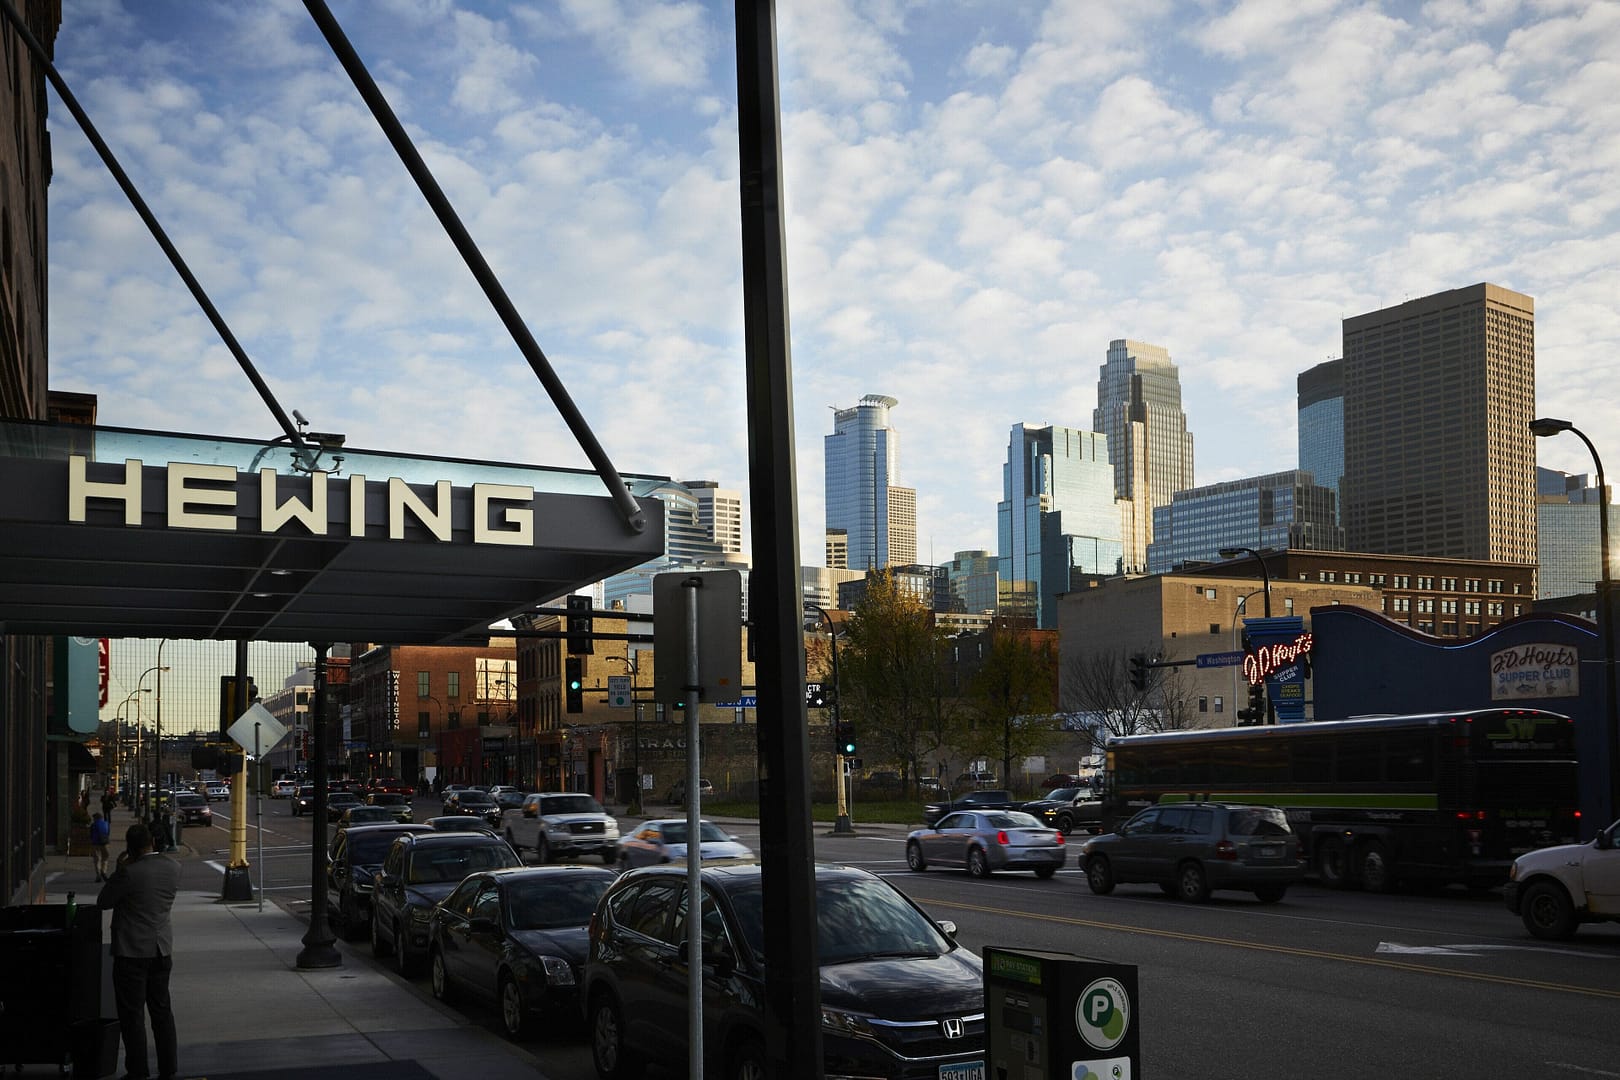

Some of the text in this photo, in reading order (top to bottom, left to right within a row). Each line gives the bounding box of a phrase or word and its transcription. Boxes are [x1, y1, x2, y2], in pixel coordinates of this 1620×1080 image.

[68, 455, 535, 547] HEWING
[1273, 665, 1299, 680] SUPPER
[1279, 671, 1297, 682] CLUB
[1499, 669, 1571, 684] SUPPER CLUB
[392, 674, 400, 730] WASHINGTON
[1091, 994, 1109, 1022] P
